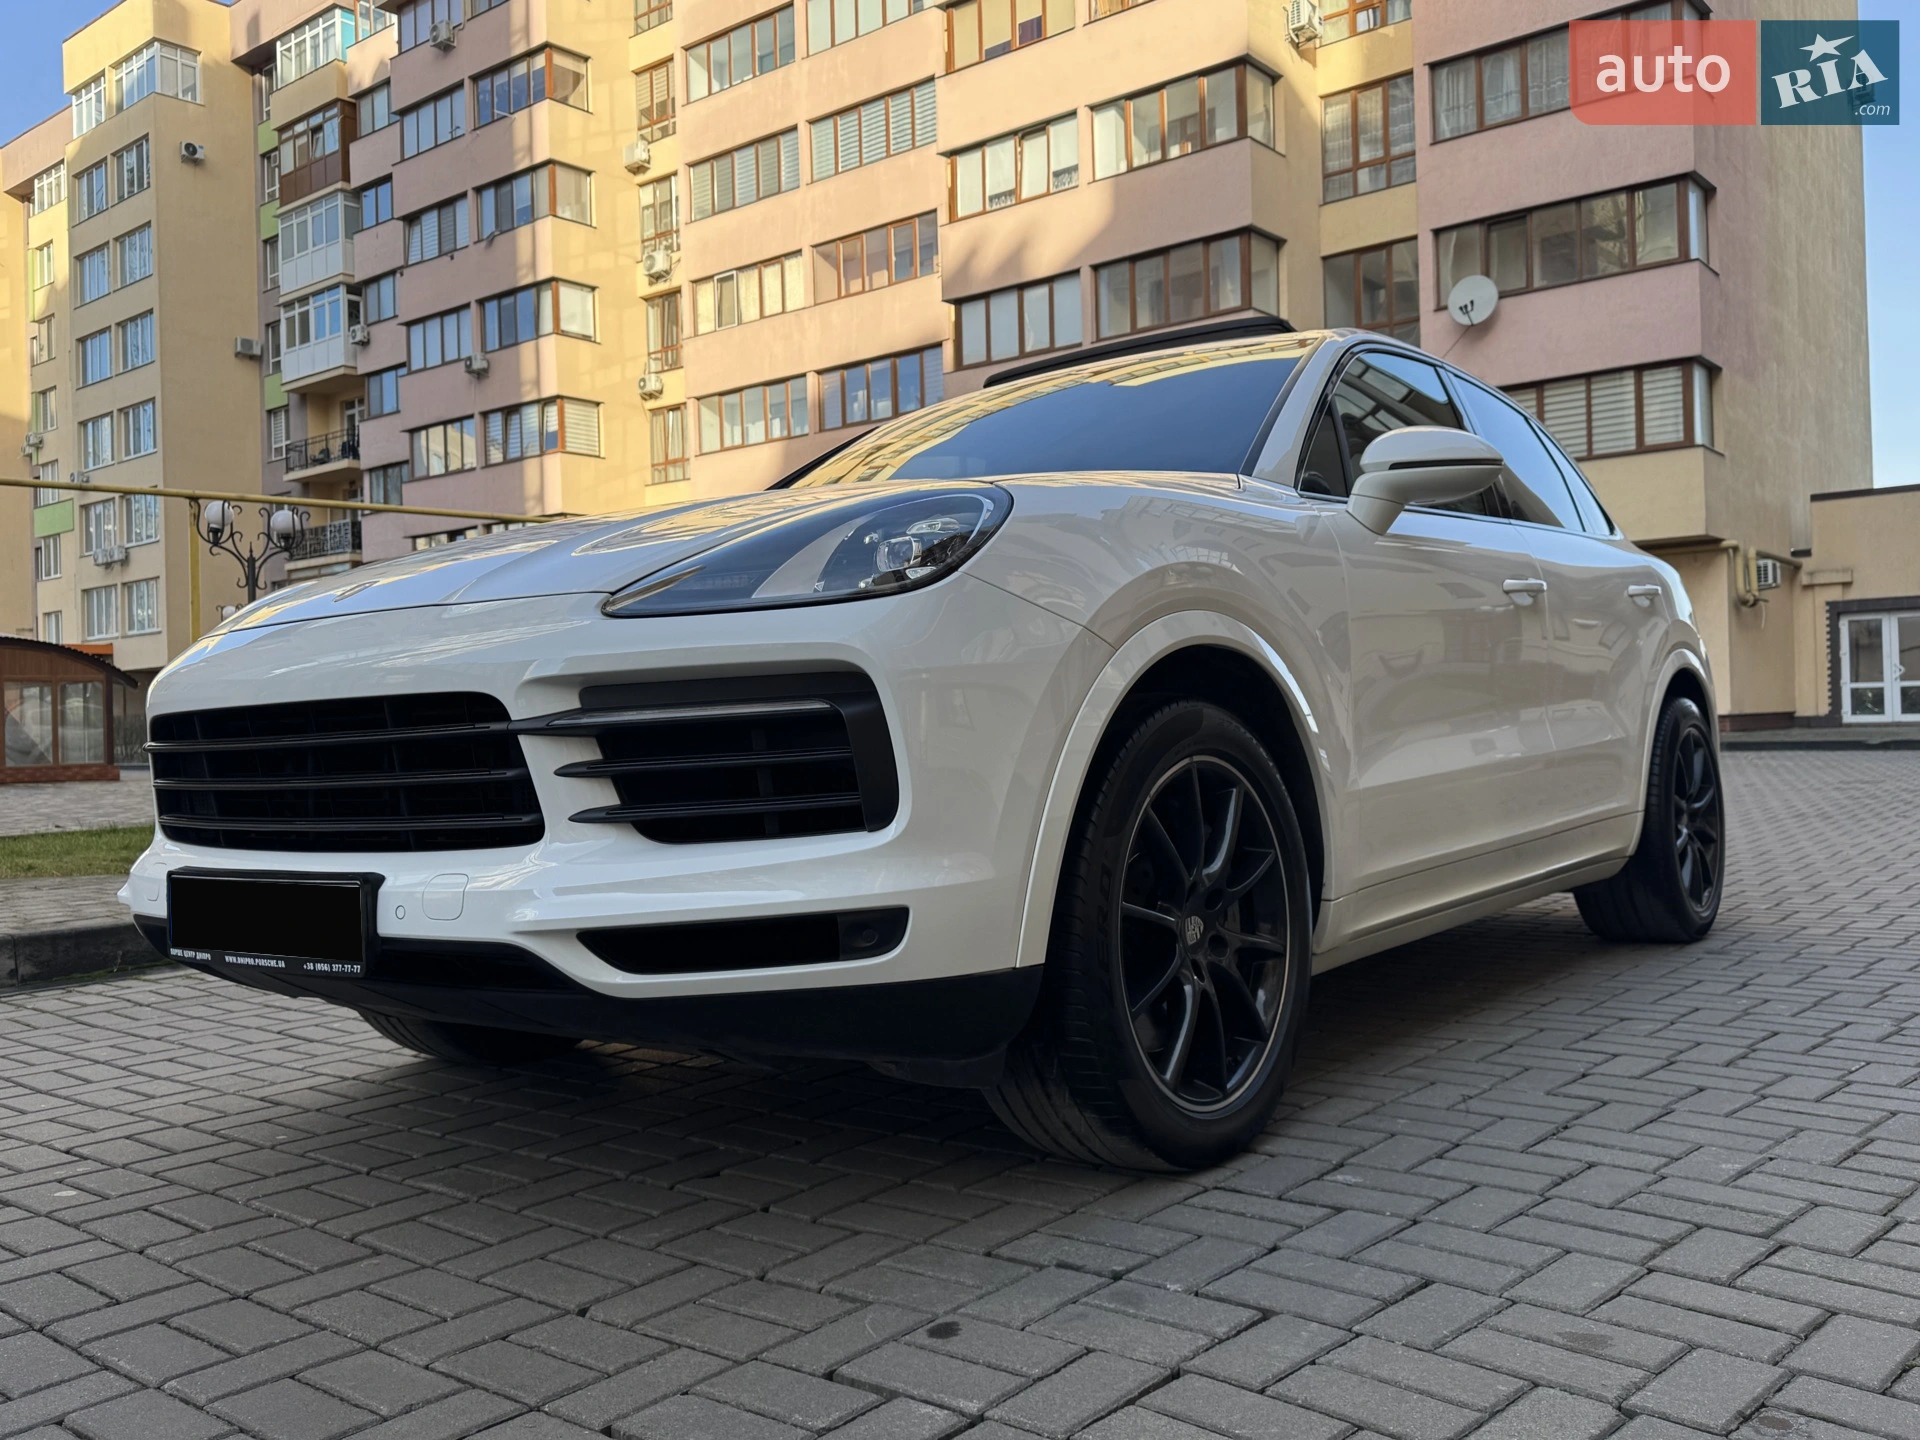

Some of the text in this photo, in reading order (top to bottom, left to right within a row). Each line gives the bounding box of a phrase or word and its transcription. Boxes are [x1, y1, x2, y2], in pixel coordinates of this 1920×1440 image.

[225, 956, 285, 968] WWW.DNIPRO.PORSCHE.UA
[303, 962, 361, 973] +38 (056) 377-77-77
